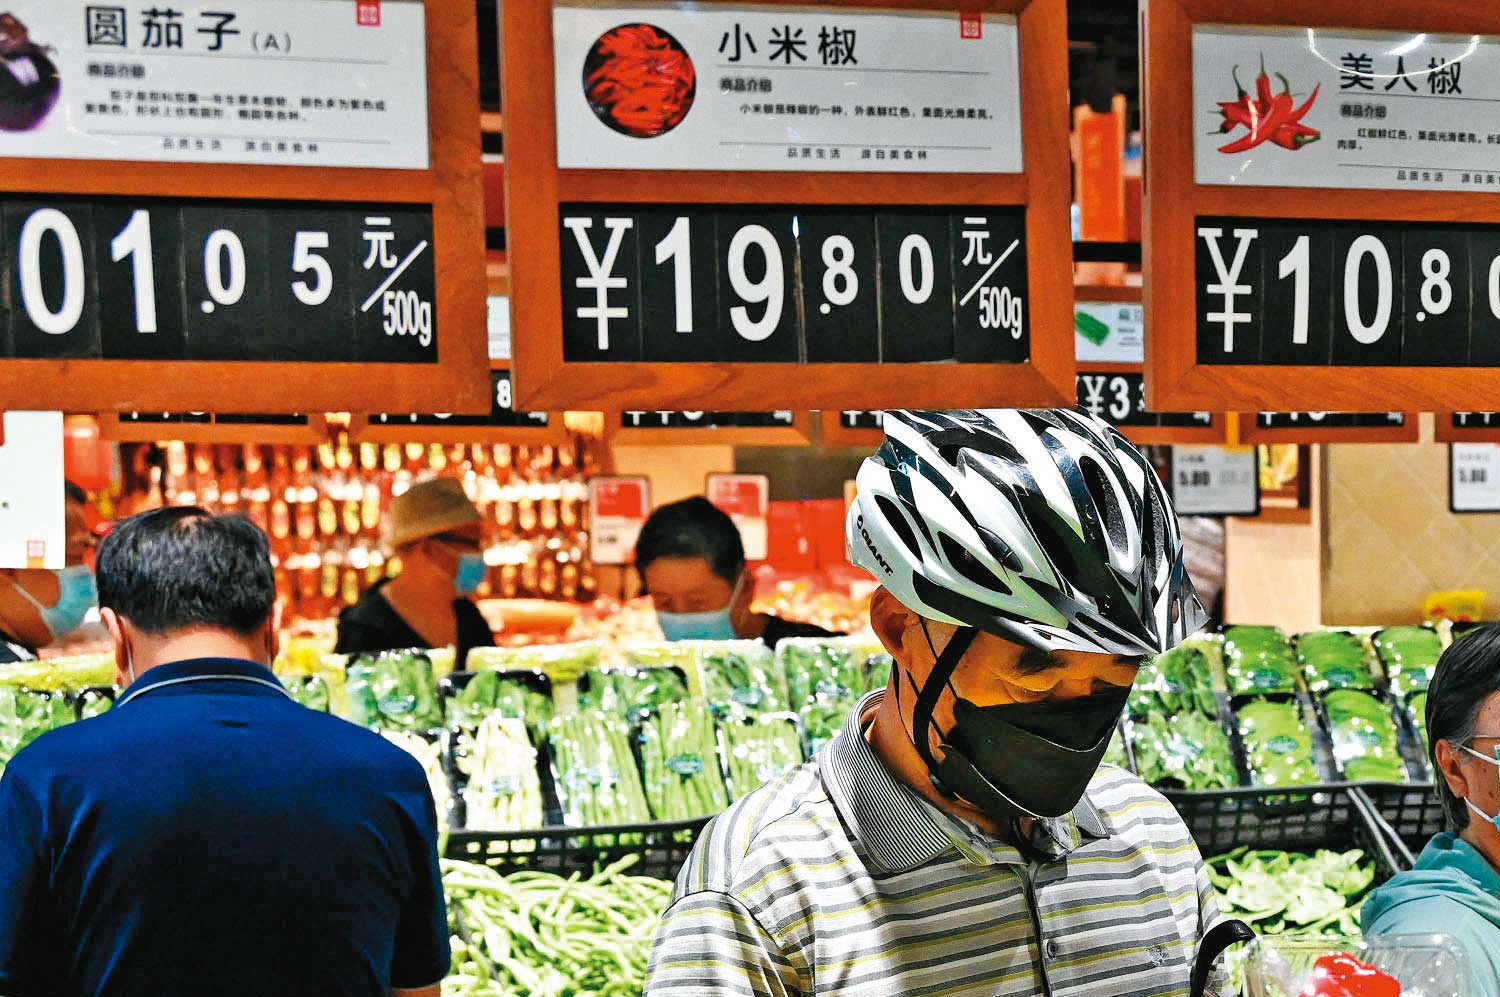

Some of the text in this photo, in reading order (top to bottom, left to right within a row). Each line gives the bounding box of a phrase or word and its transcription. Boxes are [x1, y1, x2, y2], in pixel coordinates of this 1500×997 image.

[86, 6, 292, 52] 圆茄子 (A)
[717, 23, 858, 66] 小米椒
[1340, 52, 1461, 95] 美人椒
[1340, 104, 1387, 118] 商品介绍
[861, 528, 894, 575] GIANT
